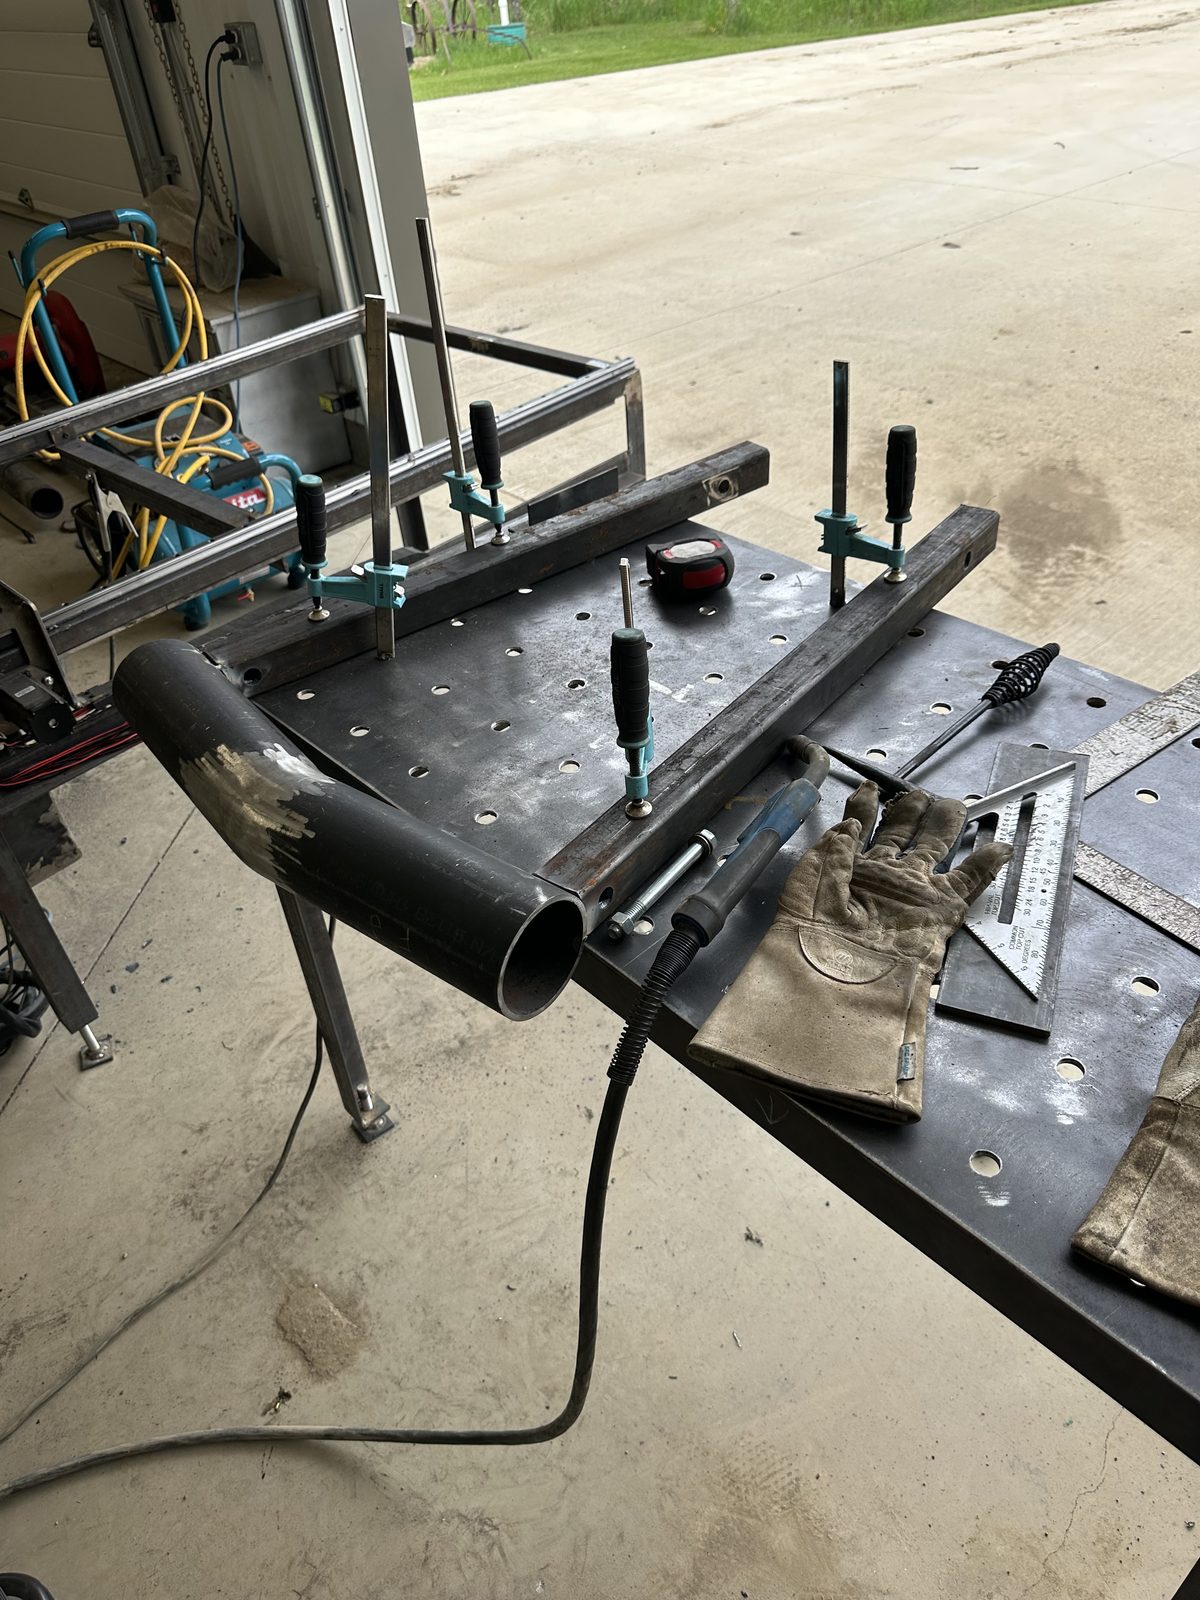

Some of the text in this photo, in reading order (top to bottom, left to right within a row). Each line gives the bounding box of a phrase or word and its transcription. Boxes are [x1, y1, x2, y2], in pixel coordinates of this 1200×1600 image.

[1043, 878, 1051, 886] 50
[1023, 908, 1031, 916] 30
[1009, 925, 1019, 950] COMMON
[1022, 939, 1031, 964] DEGREES
[1030, 949, 1040, 959] 80
